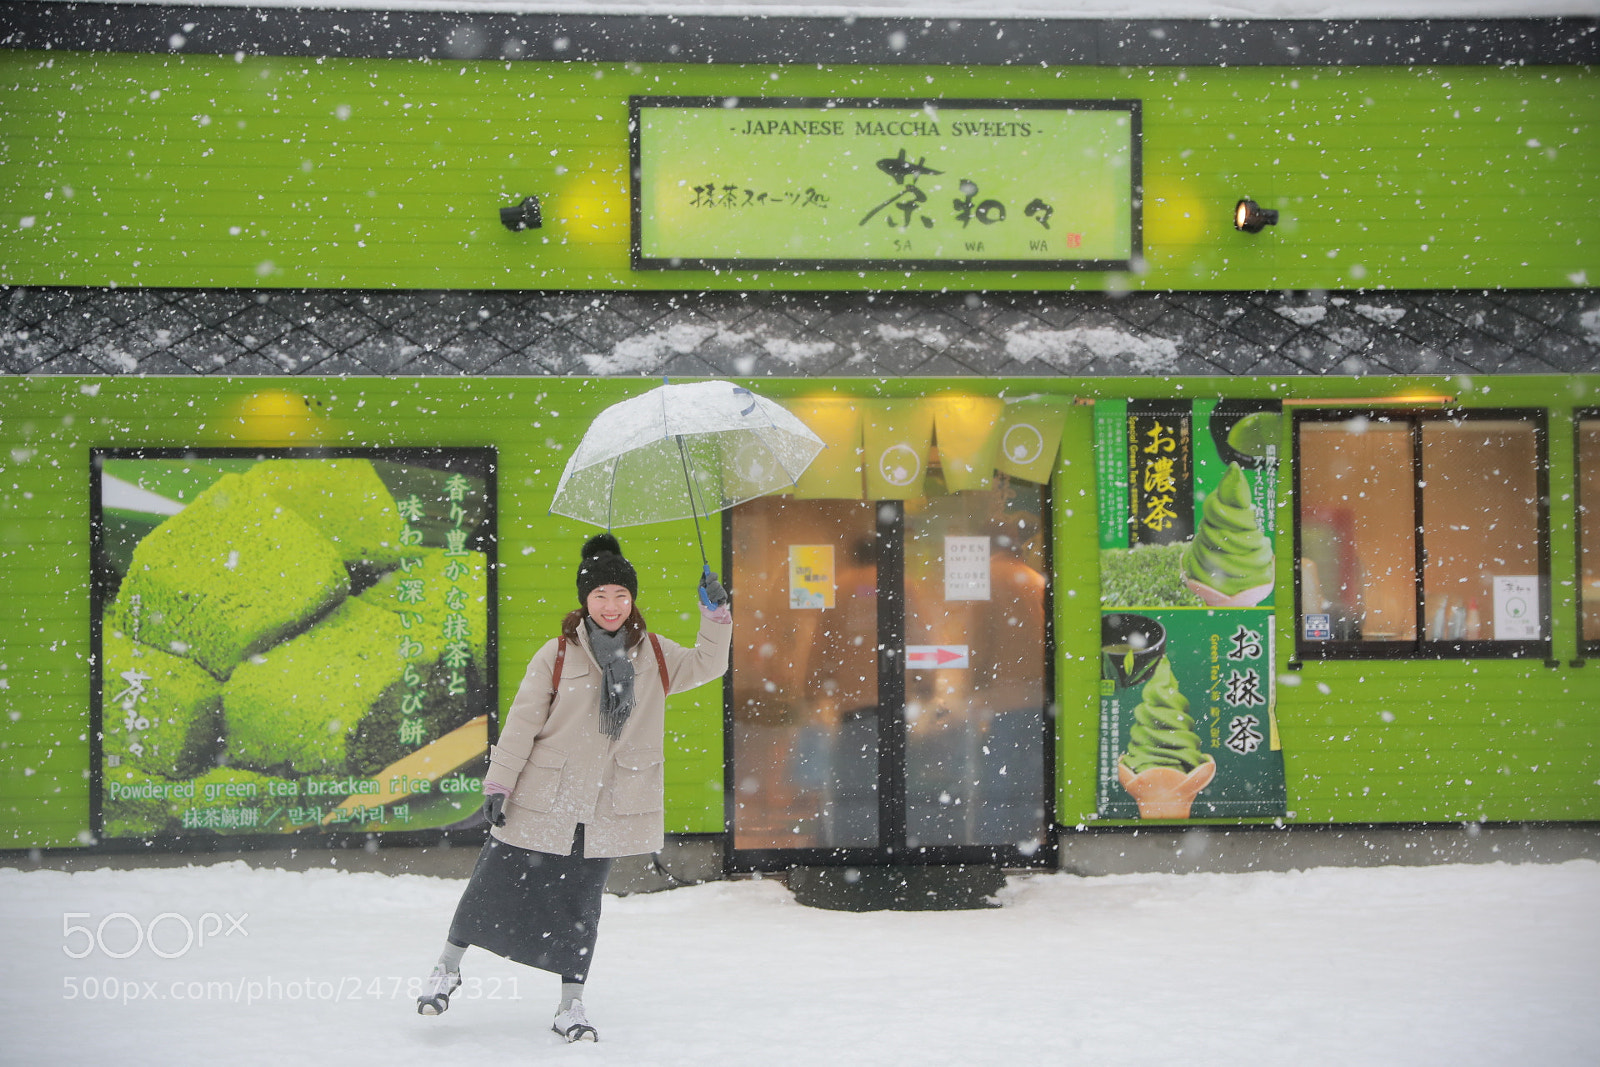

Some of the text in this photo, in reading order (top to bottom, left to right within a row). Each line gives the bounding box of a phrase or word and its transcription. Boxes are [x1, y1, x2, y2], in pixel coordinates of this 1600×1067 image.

[857, 121, 940, 136] MACCHA
[859, 148, 1055, 230] 茶和々
[894, 240, 1048, 252] SA WA WA
[1142, 420, 1178, 532] お濃茶
[950, 544, 985, 553] OPEN
[442, 472, 473, 695] 香り豊かな抹茶と
[950, 572, 986, 580] CLOSE
[397, 498, 426, 745] 味わい深いわらび餅
[1210, 634, 1220, 663] Green
[1210, 664, 1220, 681] Tea
[1224, 625, 1266, 755] お抹茶
[110, 776, 480, 801] Powdered green tea bracken rice cake
[331, 804, 386, 825] 고사리
[393, 804, 410, 825] 떡
